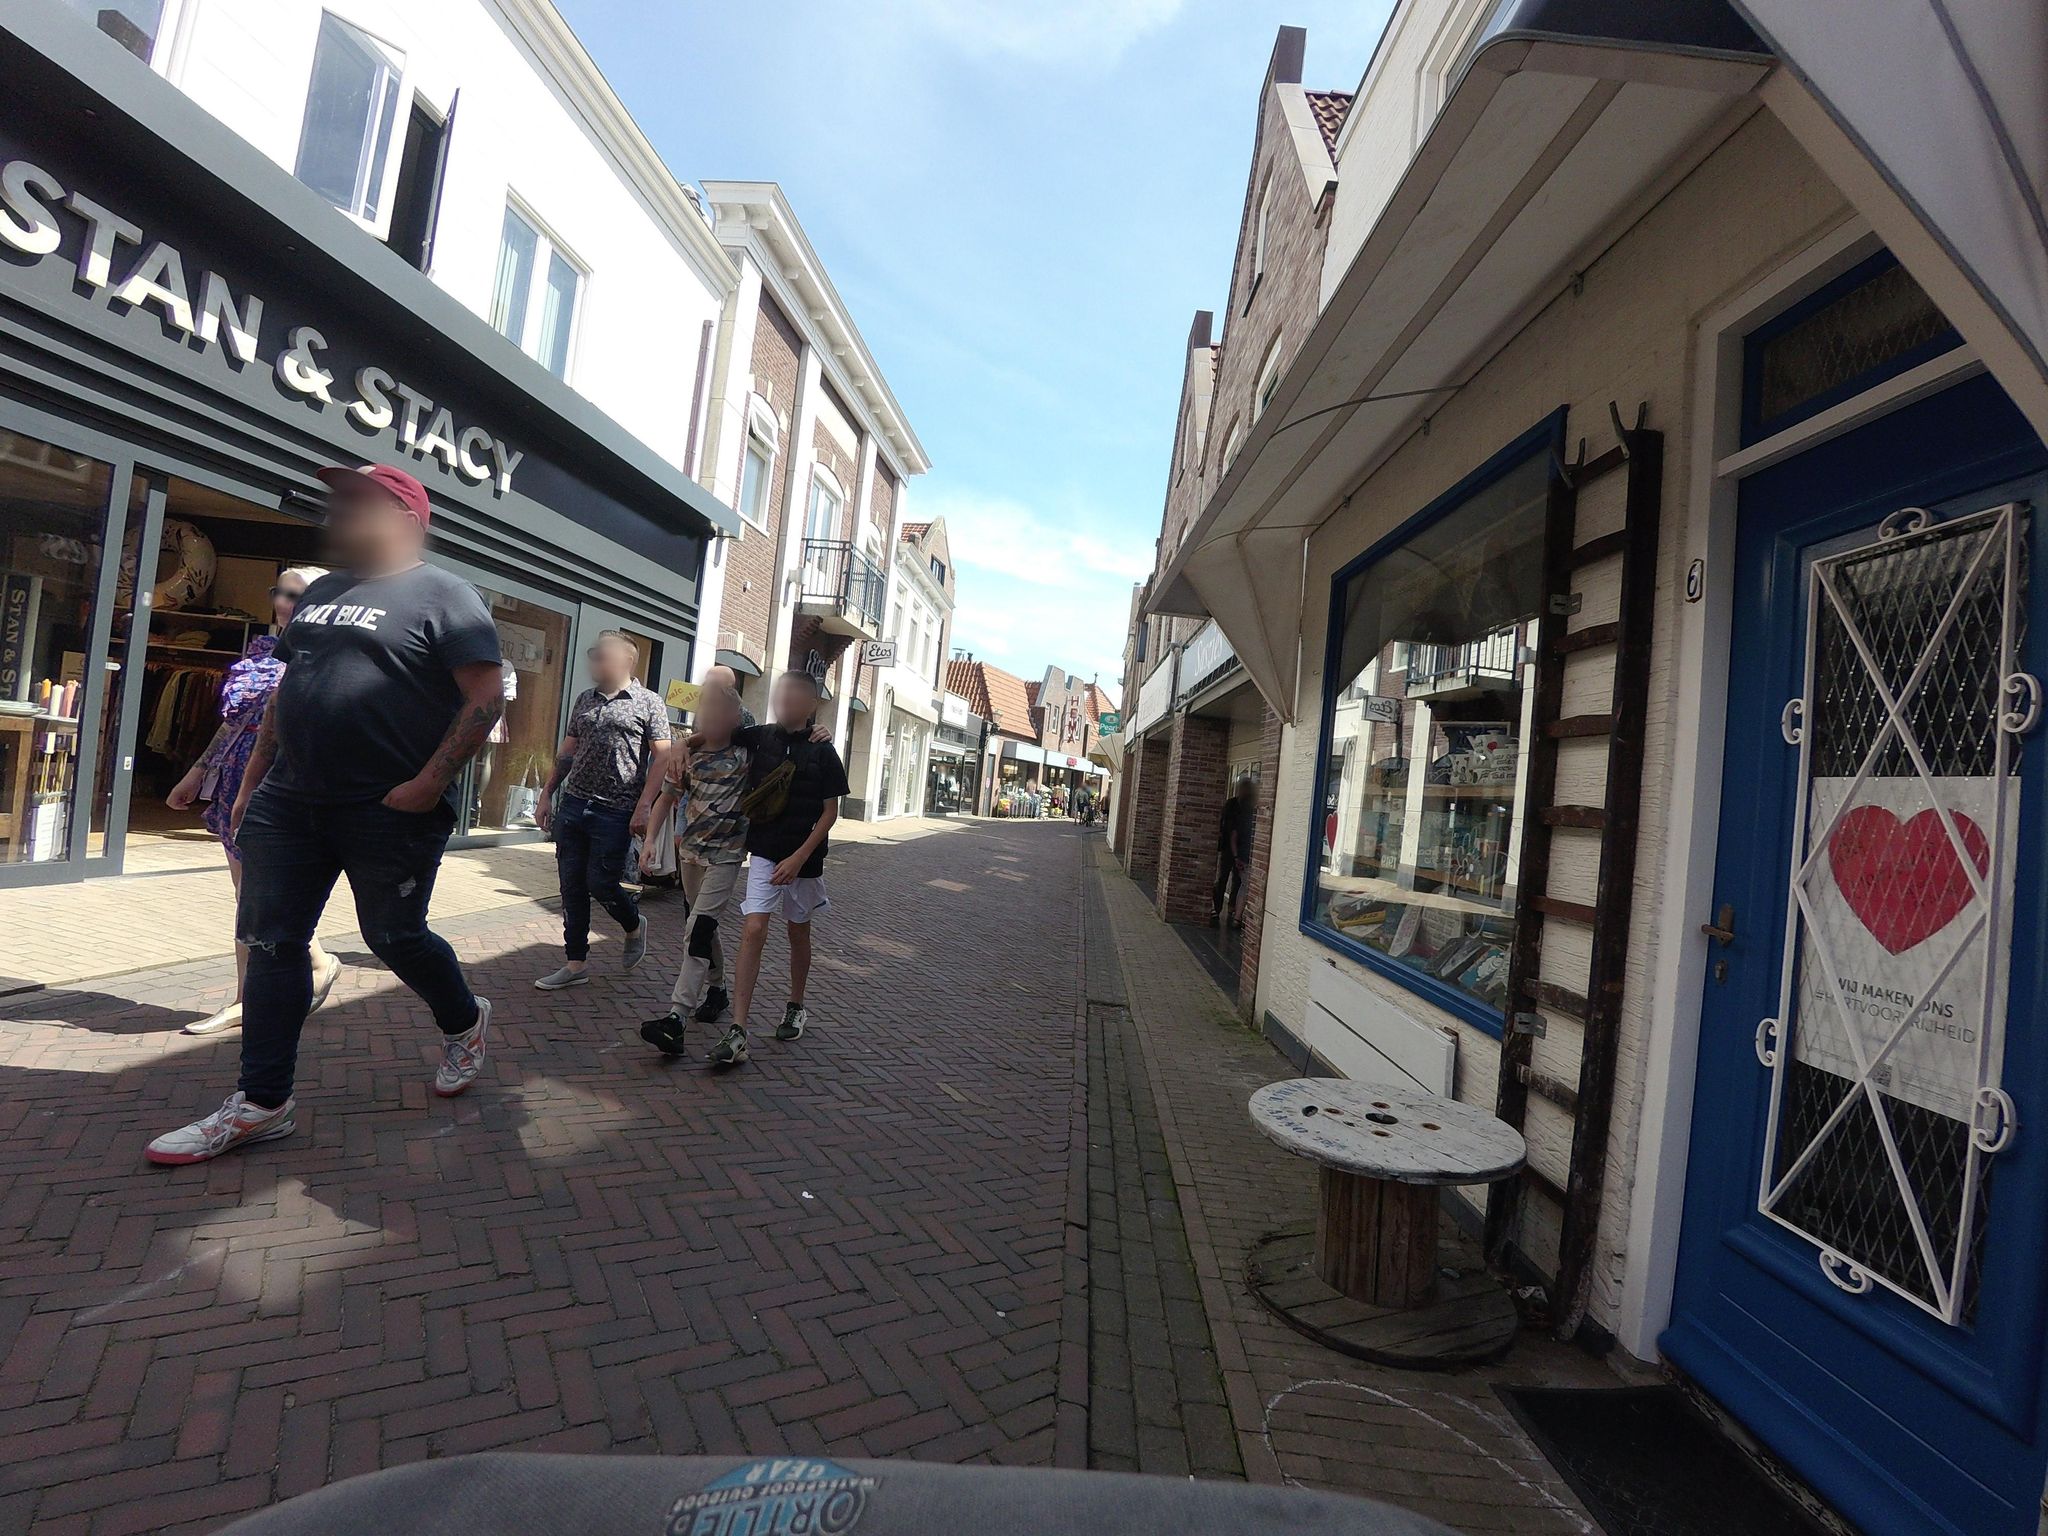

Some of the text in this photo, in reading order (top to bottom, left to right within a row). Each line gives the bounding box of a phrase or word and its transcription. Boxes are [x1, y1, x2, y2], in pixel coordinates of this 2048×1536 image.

[0, 160, 524, 494] STAN & STACY
[5, 589, 26, 643] STAN
[869, 643, 892, 658] Etos
[1862, 983, 1915, 1008] MAKEN
[1815, 989, 1977, 1043] #HRTVOORRIJHEID
[745, 1460, 826, 1483] GEAR
